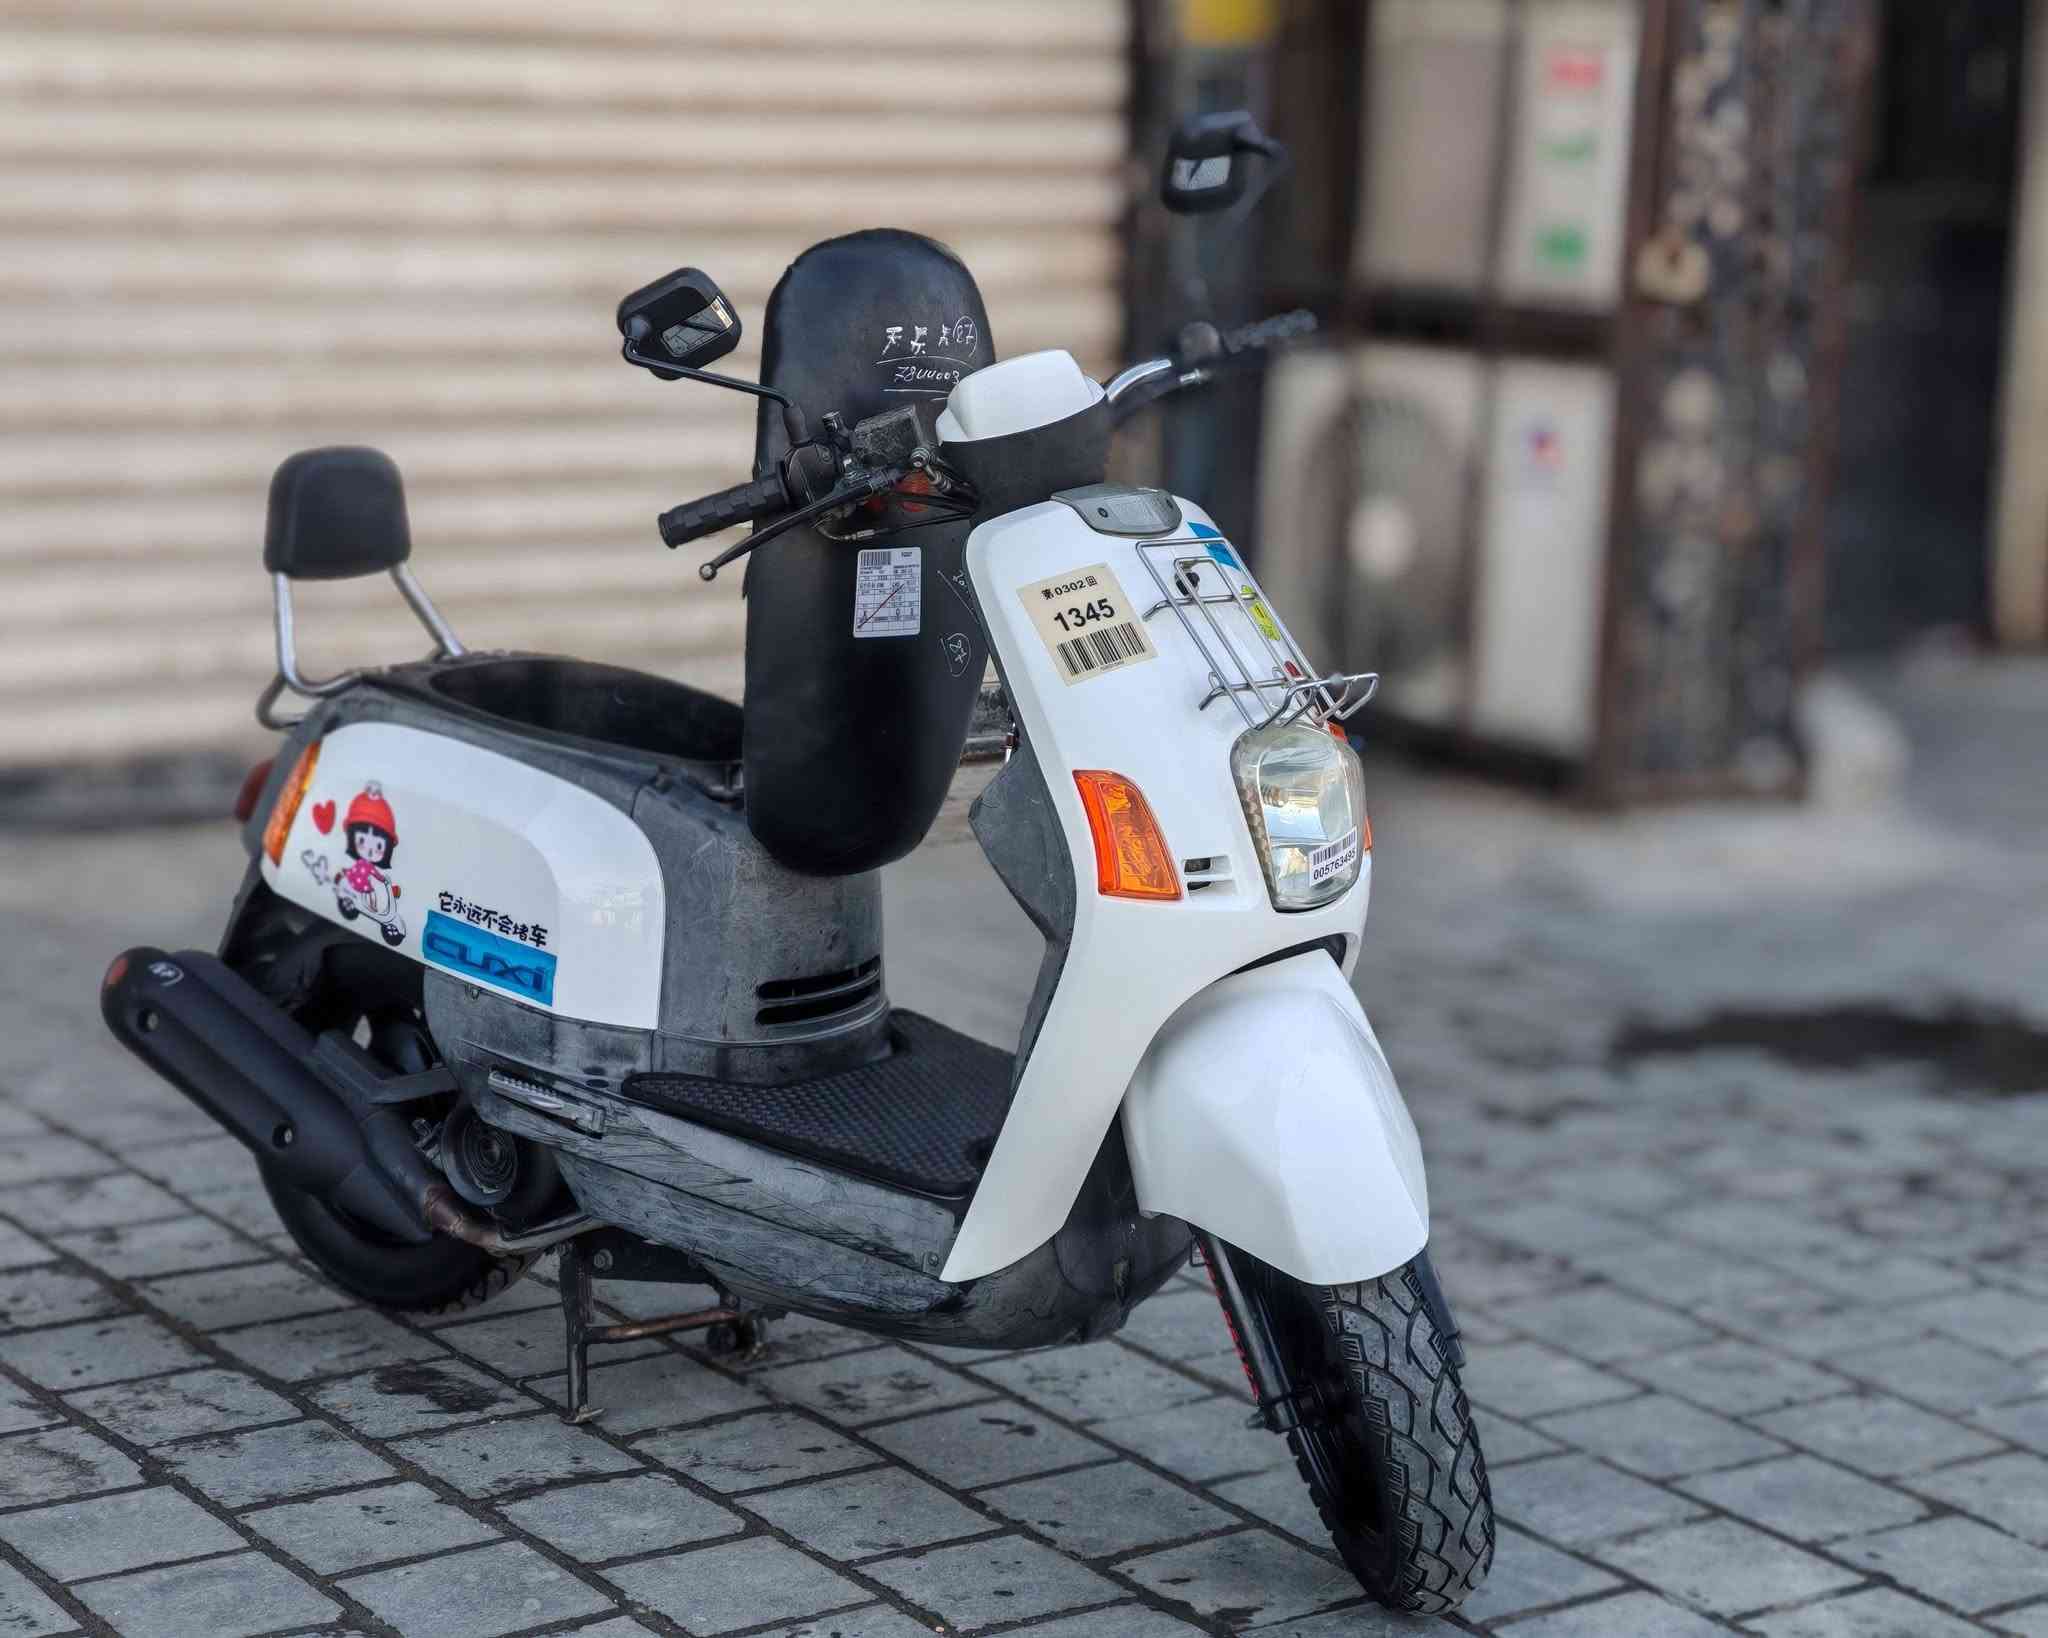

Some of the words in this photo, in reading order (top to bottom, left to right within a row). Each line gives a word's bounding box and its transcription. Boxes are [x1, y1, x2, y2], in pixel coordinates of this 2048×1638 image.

[1053, 598, 1115, 632] 1345
[438, 891, 548, 947] 它永远不会堵车
